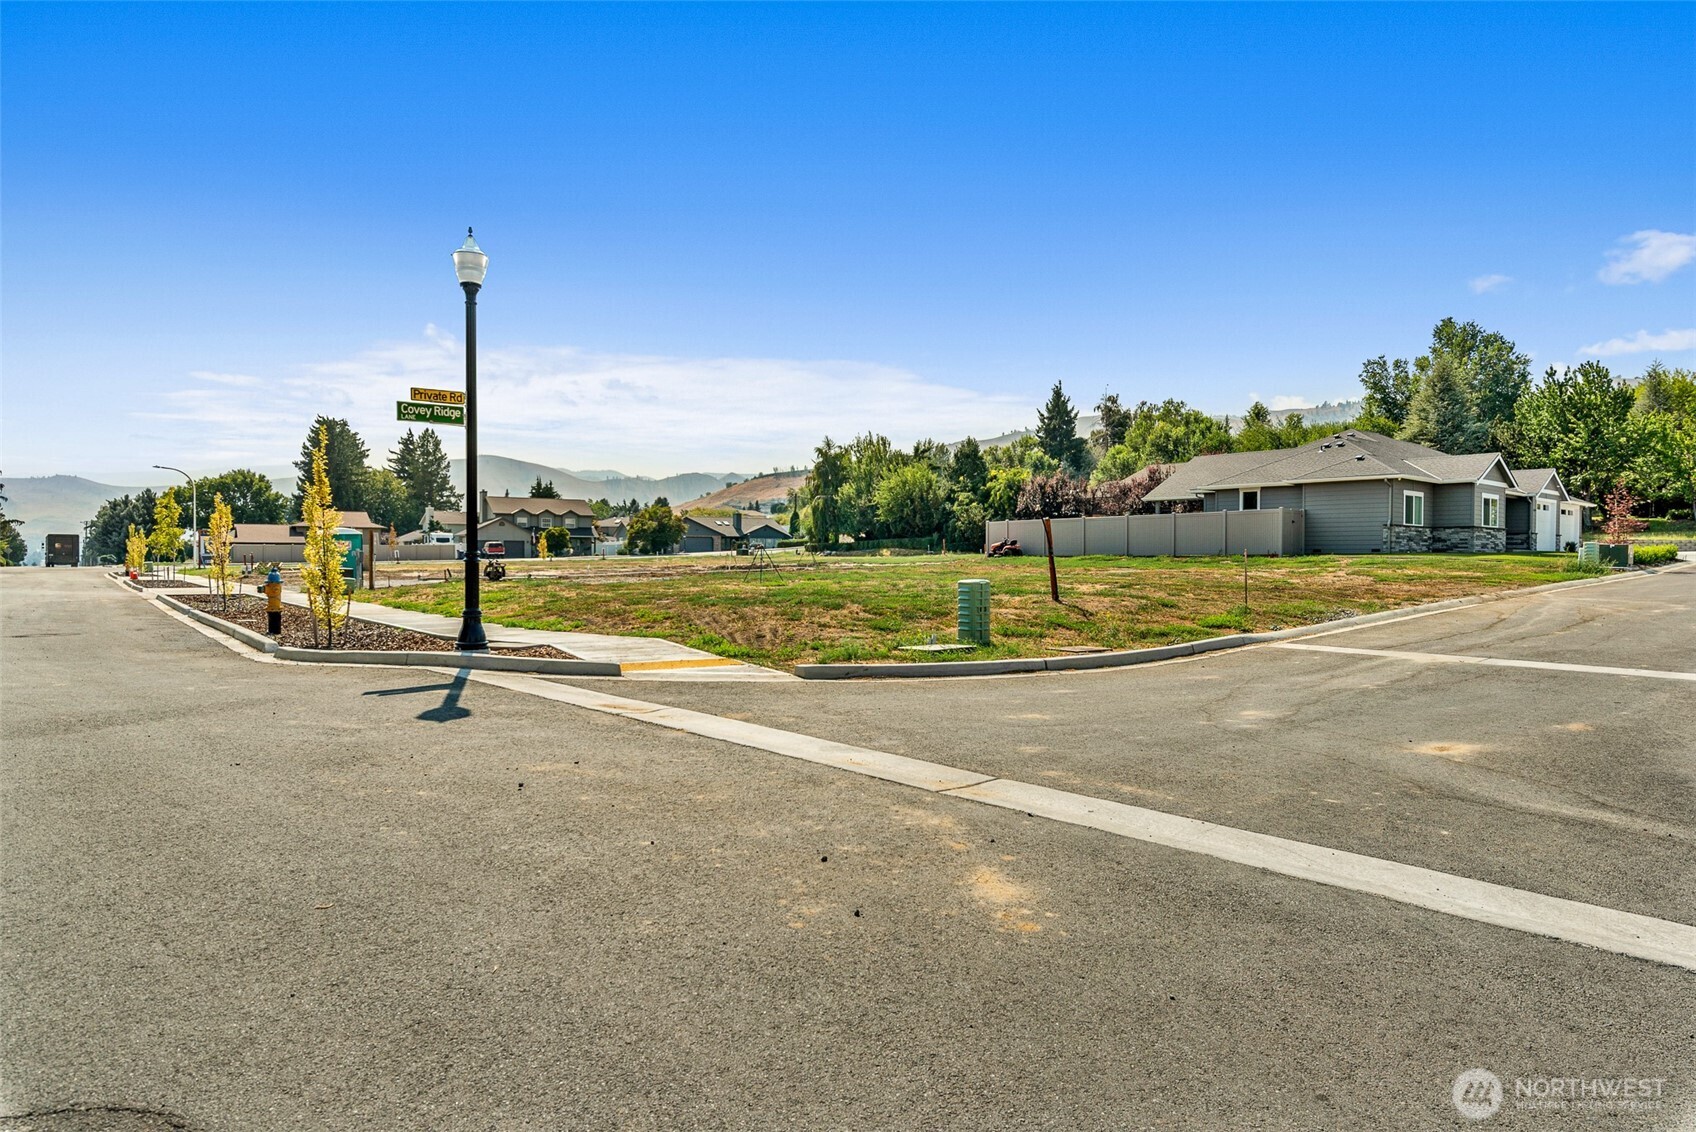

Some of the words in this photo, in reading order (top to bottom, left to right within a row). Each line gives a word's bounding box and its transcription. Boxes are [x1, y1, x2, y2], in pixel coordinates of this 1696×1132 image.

[413, 389, 447, 401] Private
[449, 392, 463, 402] Rd
[400, 403, 432, 418] Covey
[434, 406, 461, 419] Ridge
